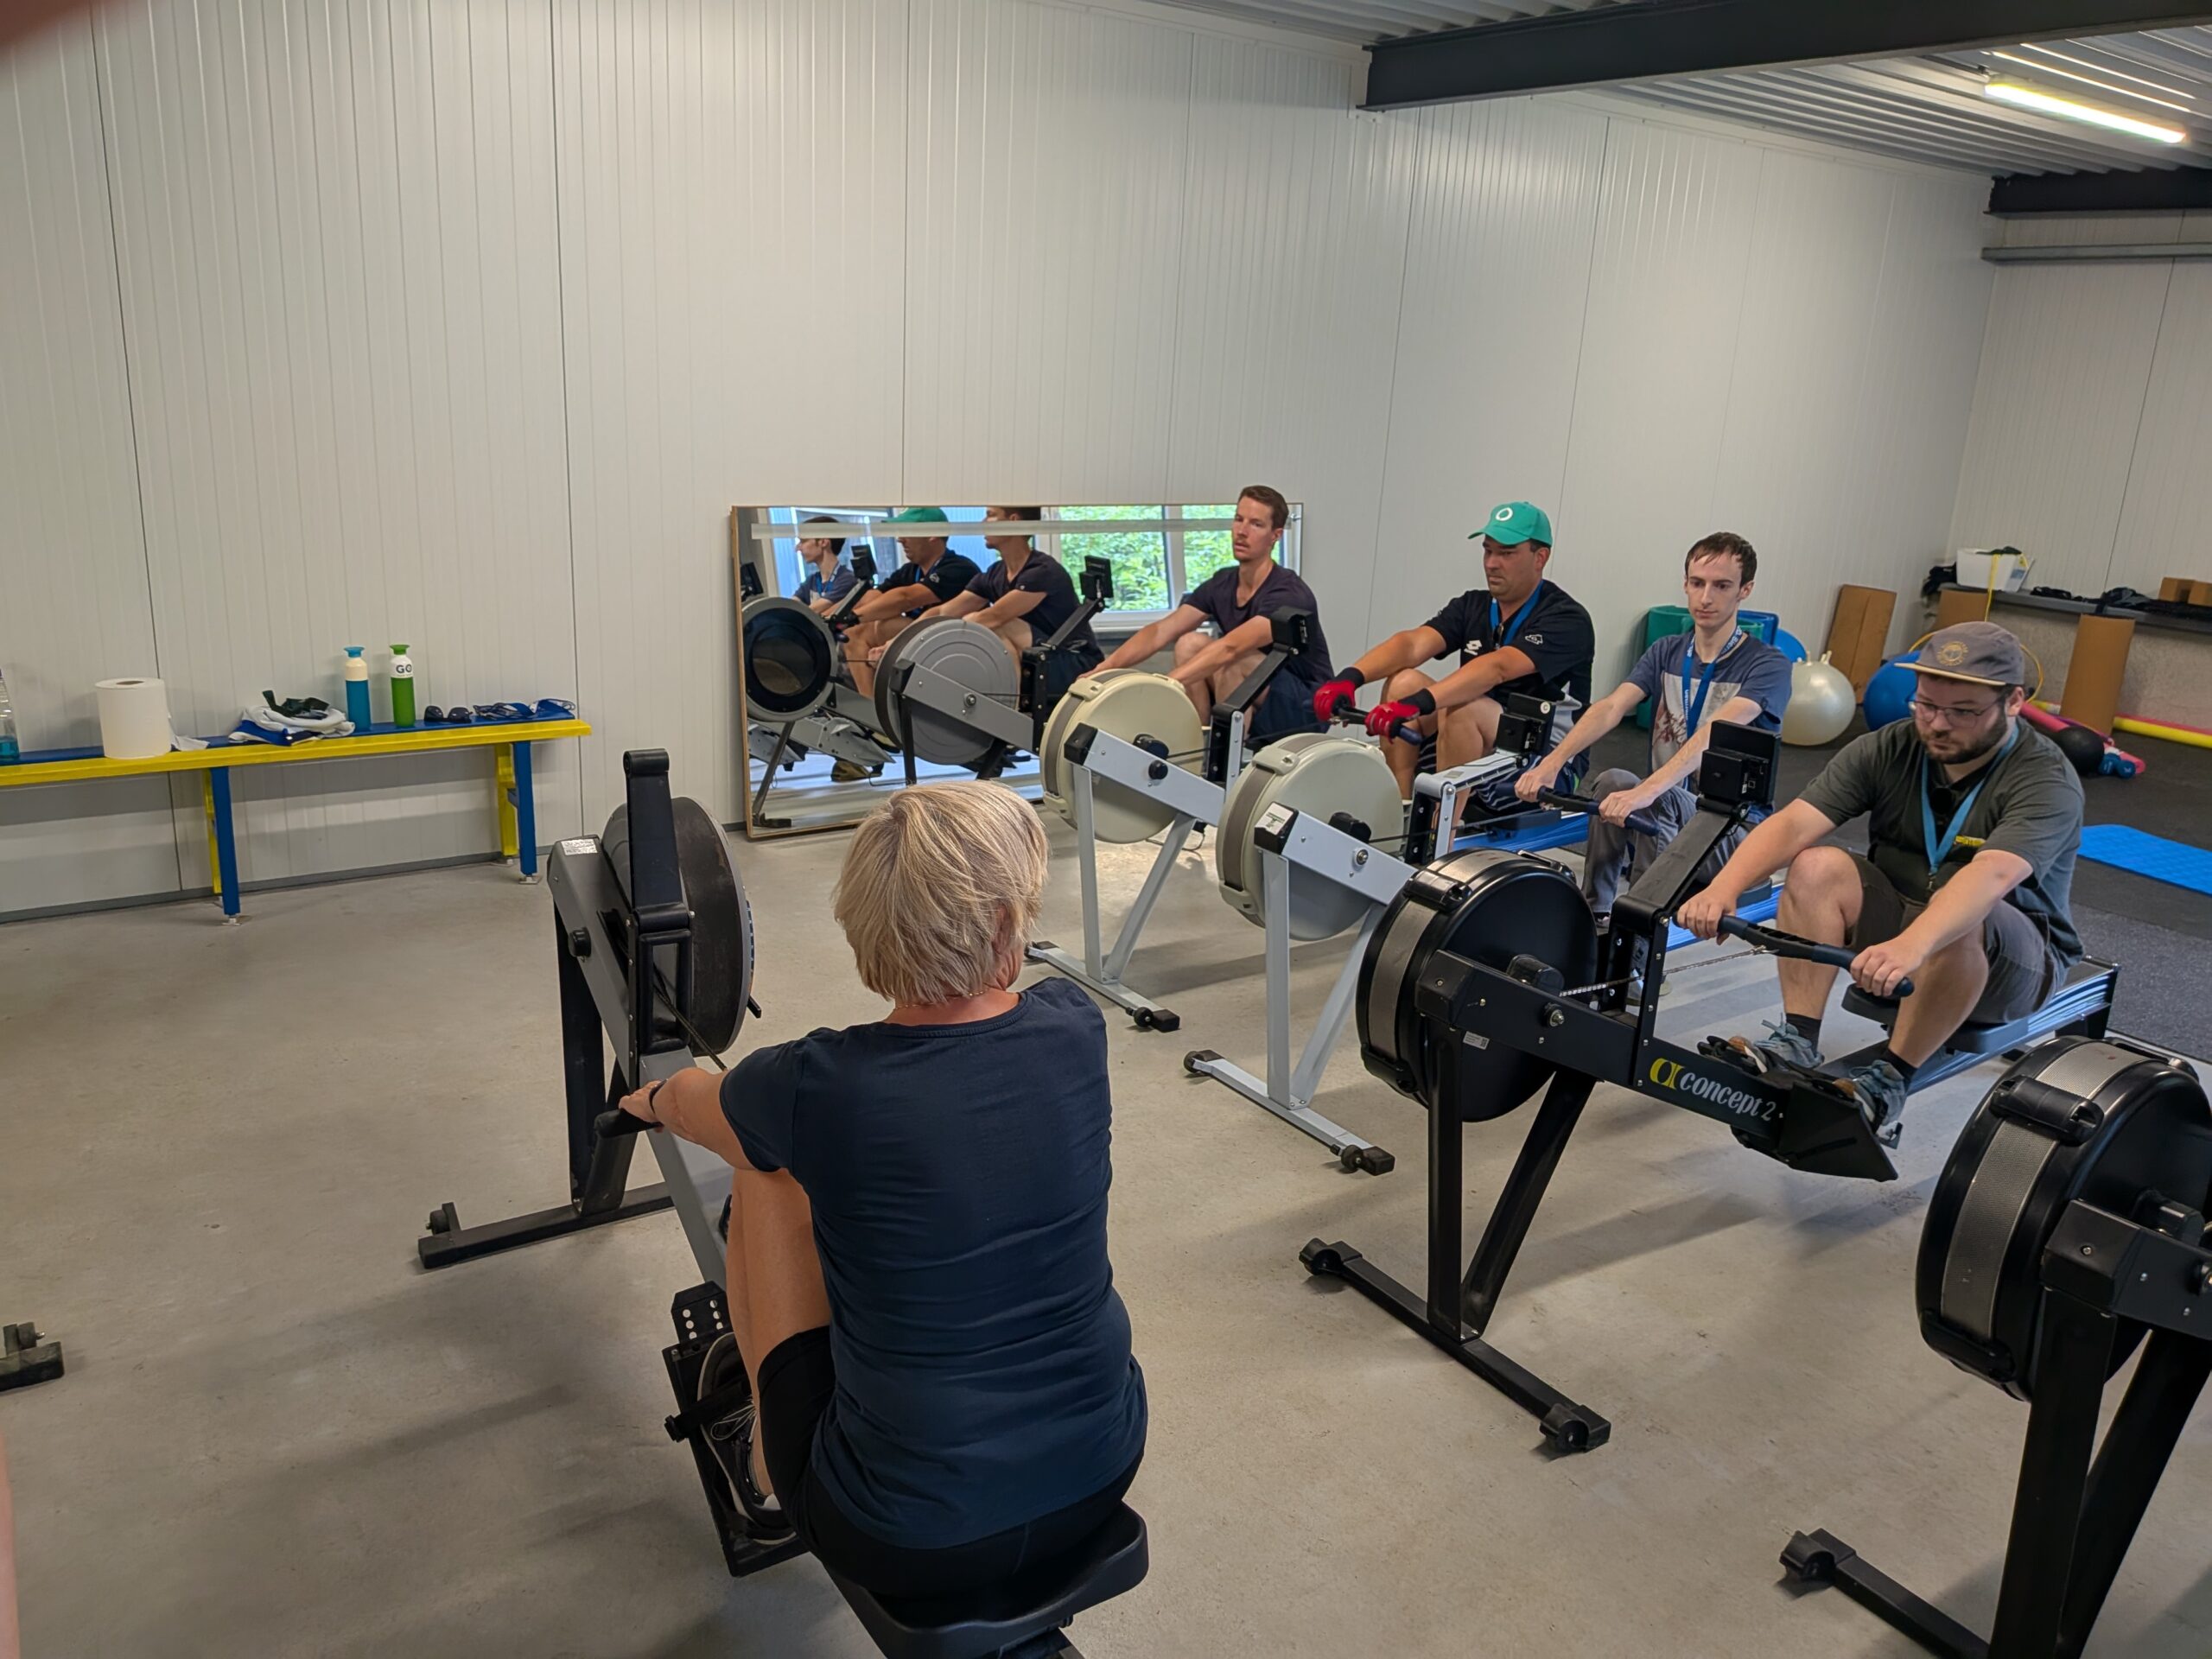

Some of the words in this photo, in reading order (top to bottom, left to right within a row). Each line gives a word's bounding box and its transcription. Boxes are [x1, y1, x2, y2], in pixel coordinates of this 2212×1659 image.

[396, 664, 412, 674] GO
[1680, 1072, 1763, 1116] concept
[1761, 1101, 1777, 1121] 2
